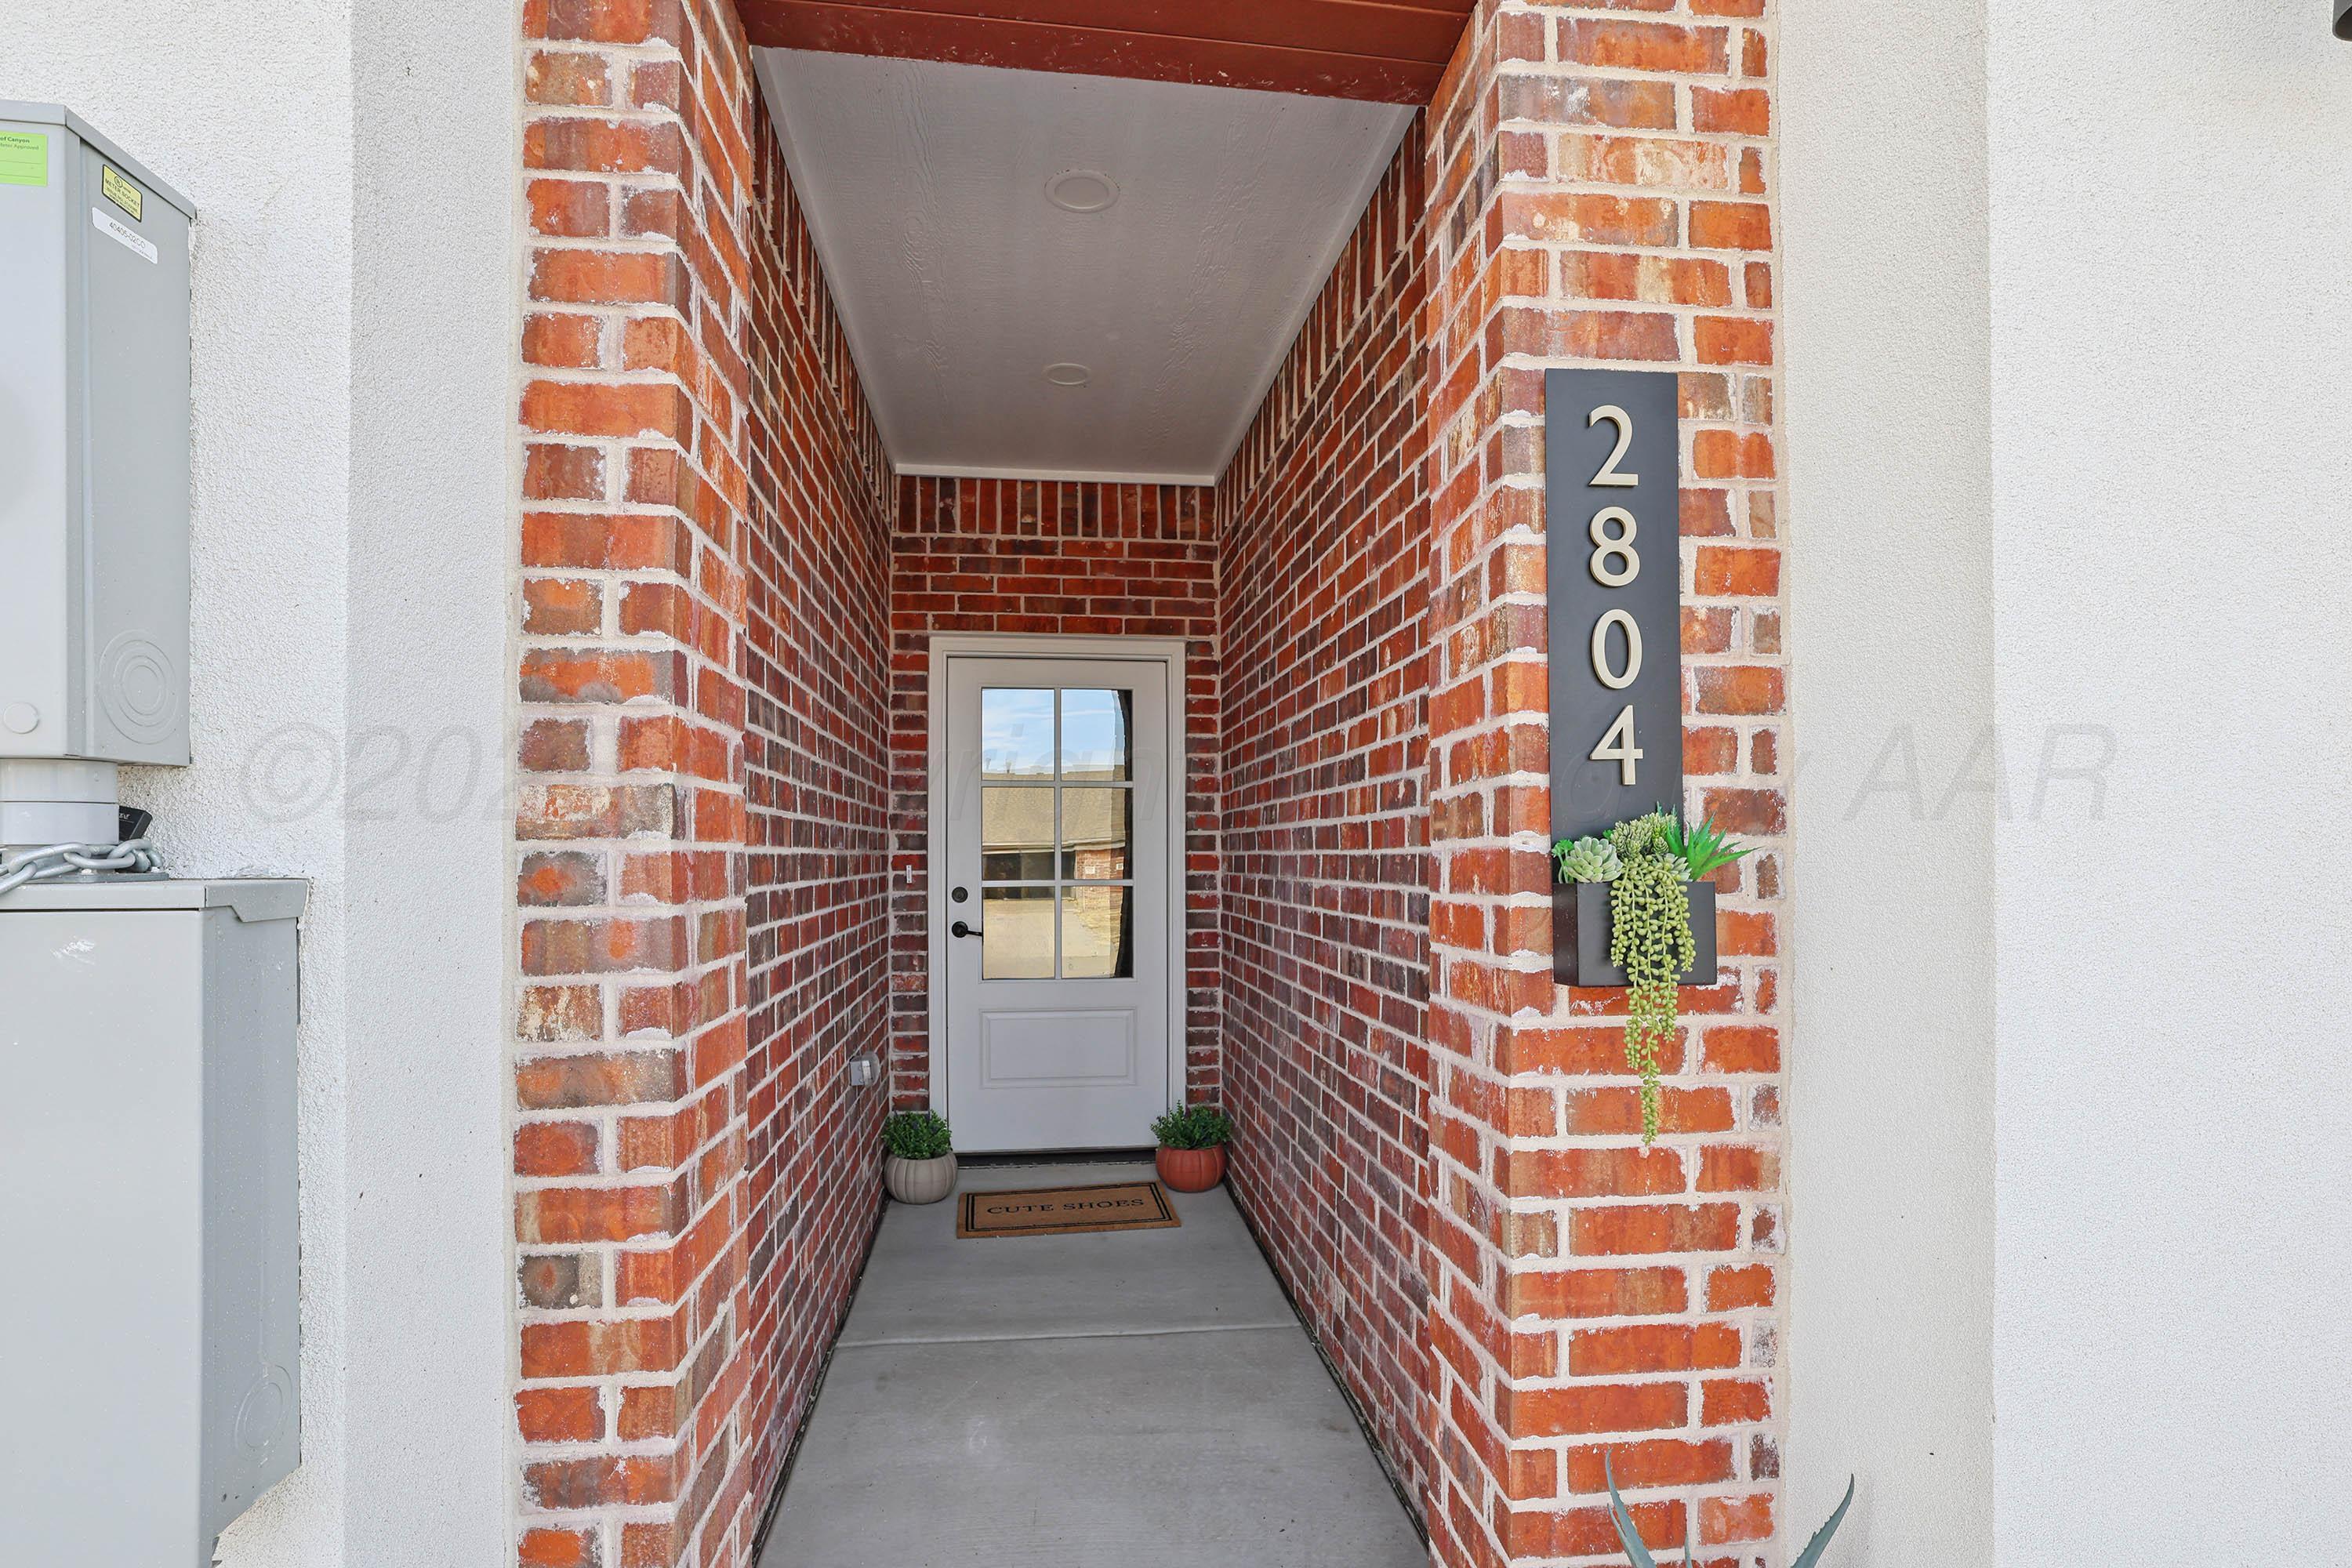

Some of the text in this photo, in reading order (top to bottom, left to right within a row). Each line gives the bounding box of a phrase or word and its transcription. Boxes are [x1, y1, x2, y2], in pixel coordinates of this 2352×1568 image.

[105, 178, 121, 194] METER
[122, 191, 140, 207] SOCKET
[1588, 404, 1643, 786] 2804
[986, 1198, 1145, 1214] CUTE SHOES
